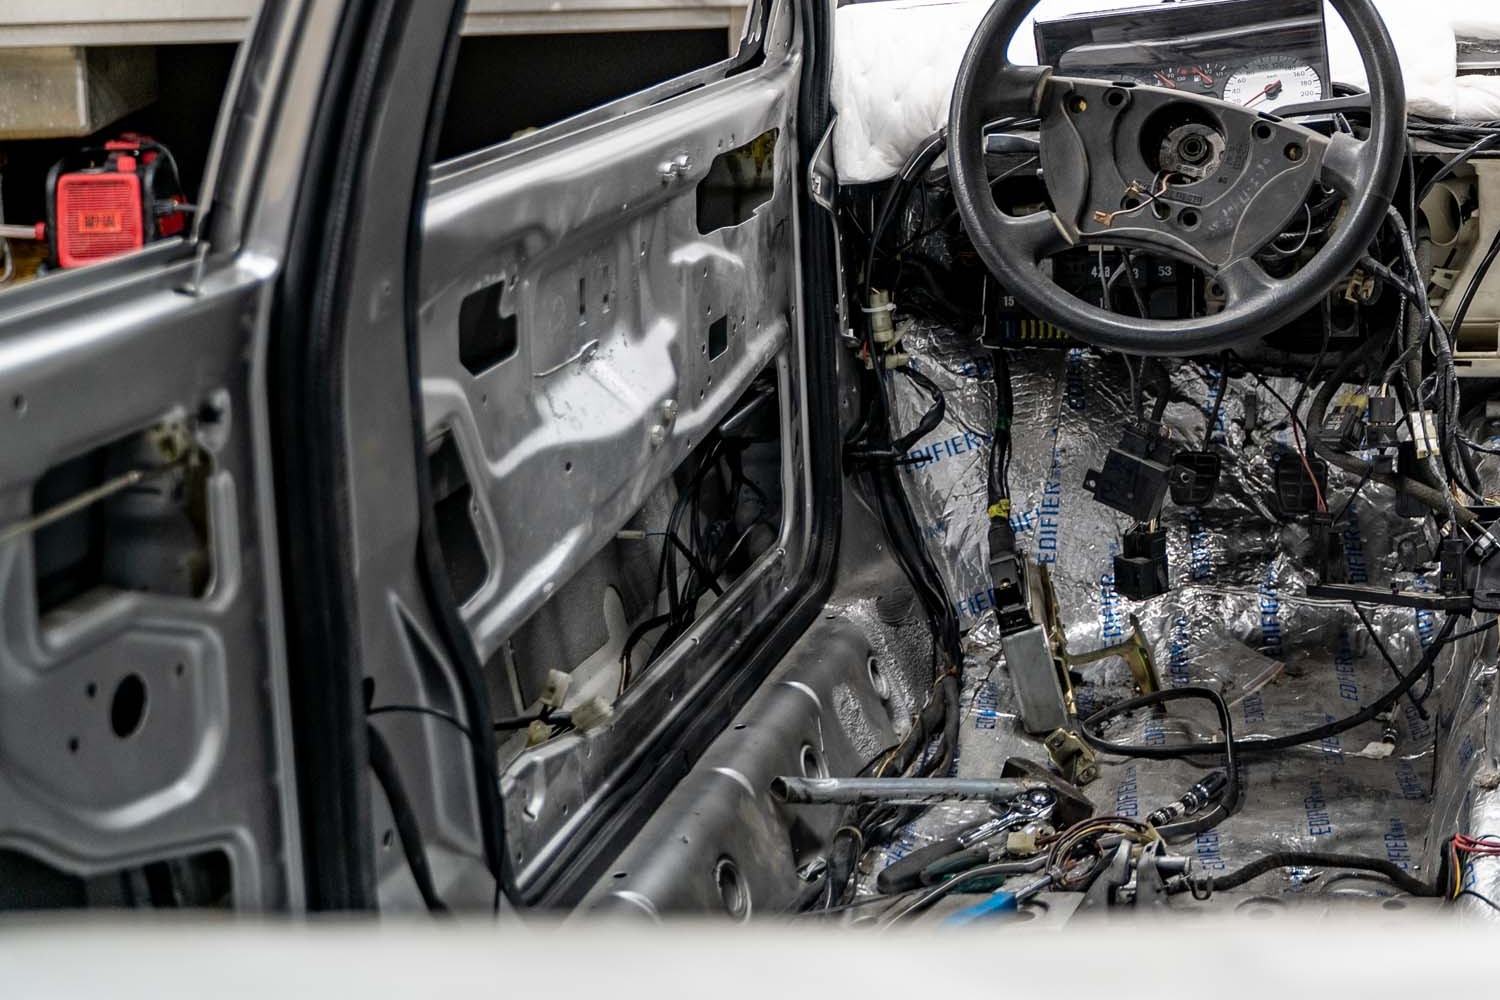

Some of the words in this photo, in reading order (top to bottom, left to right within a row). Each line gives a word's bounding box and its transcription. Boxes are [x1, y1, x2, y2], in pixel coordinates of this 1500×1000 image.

[1158, 266, 1172, 277] 53
[1003, 296, 1015, 307] 15
[1037, 482, 1060, 566] EDIFIER
